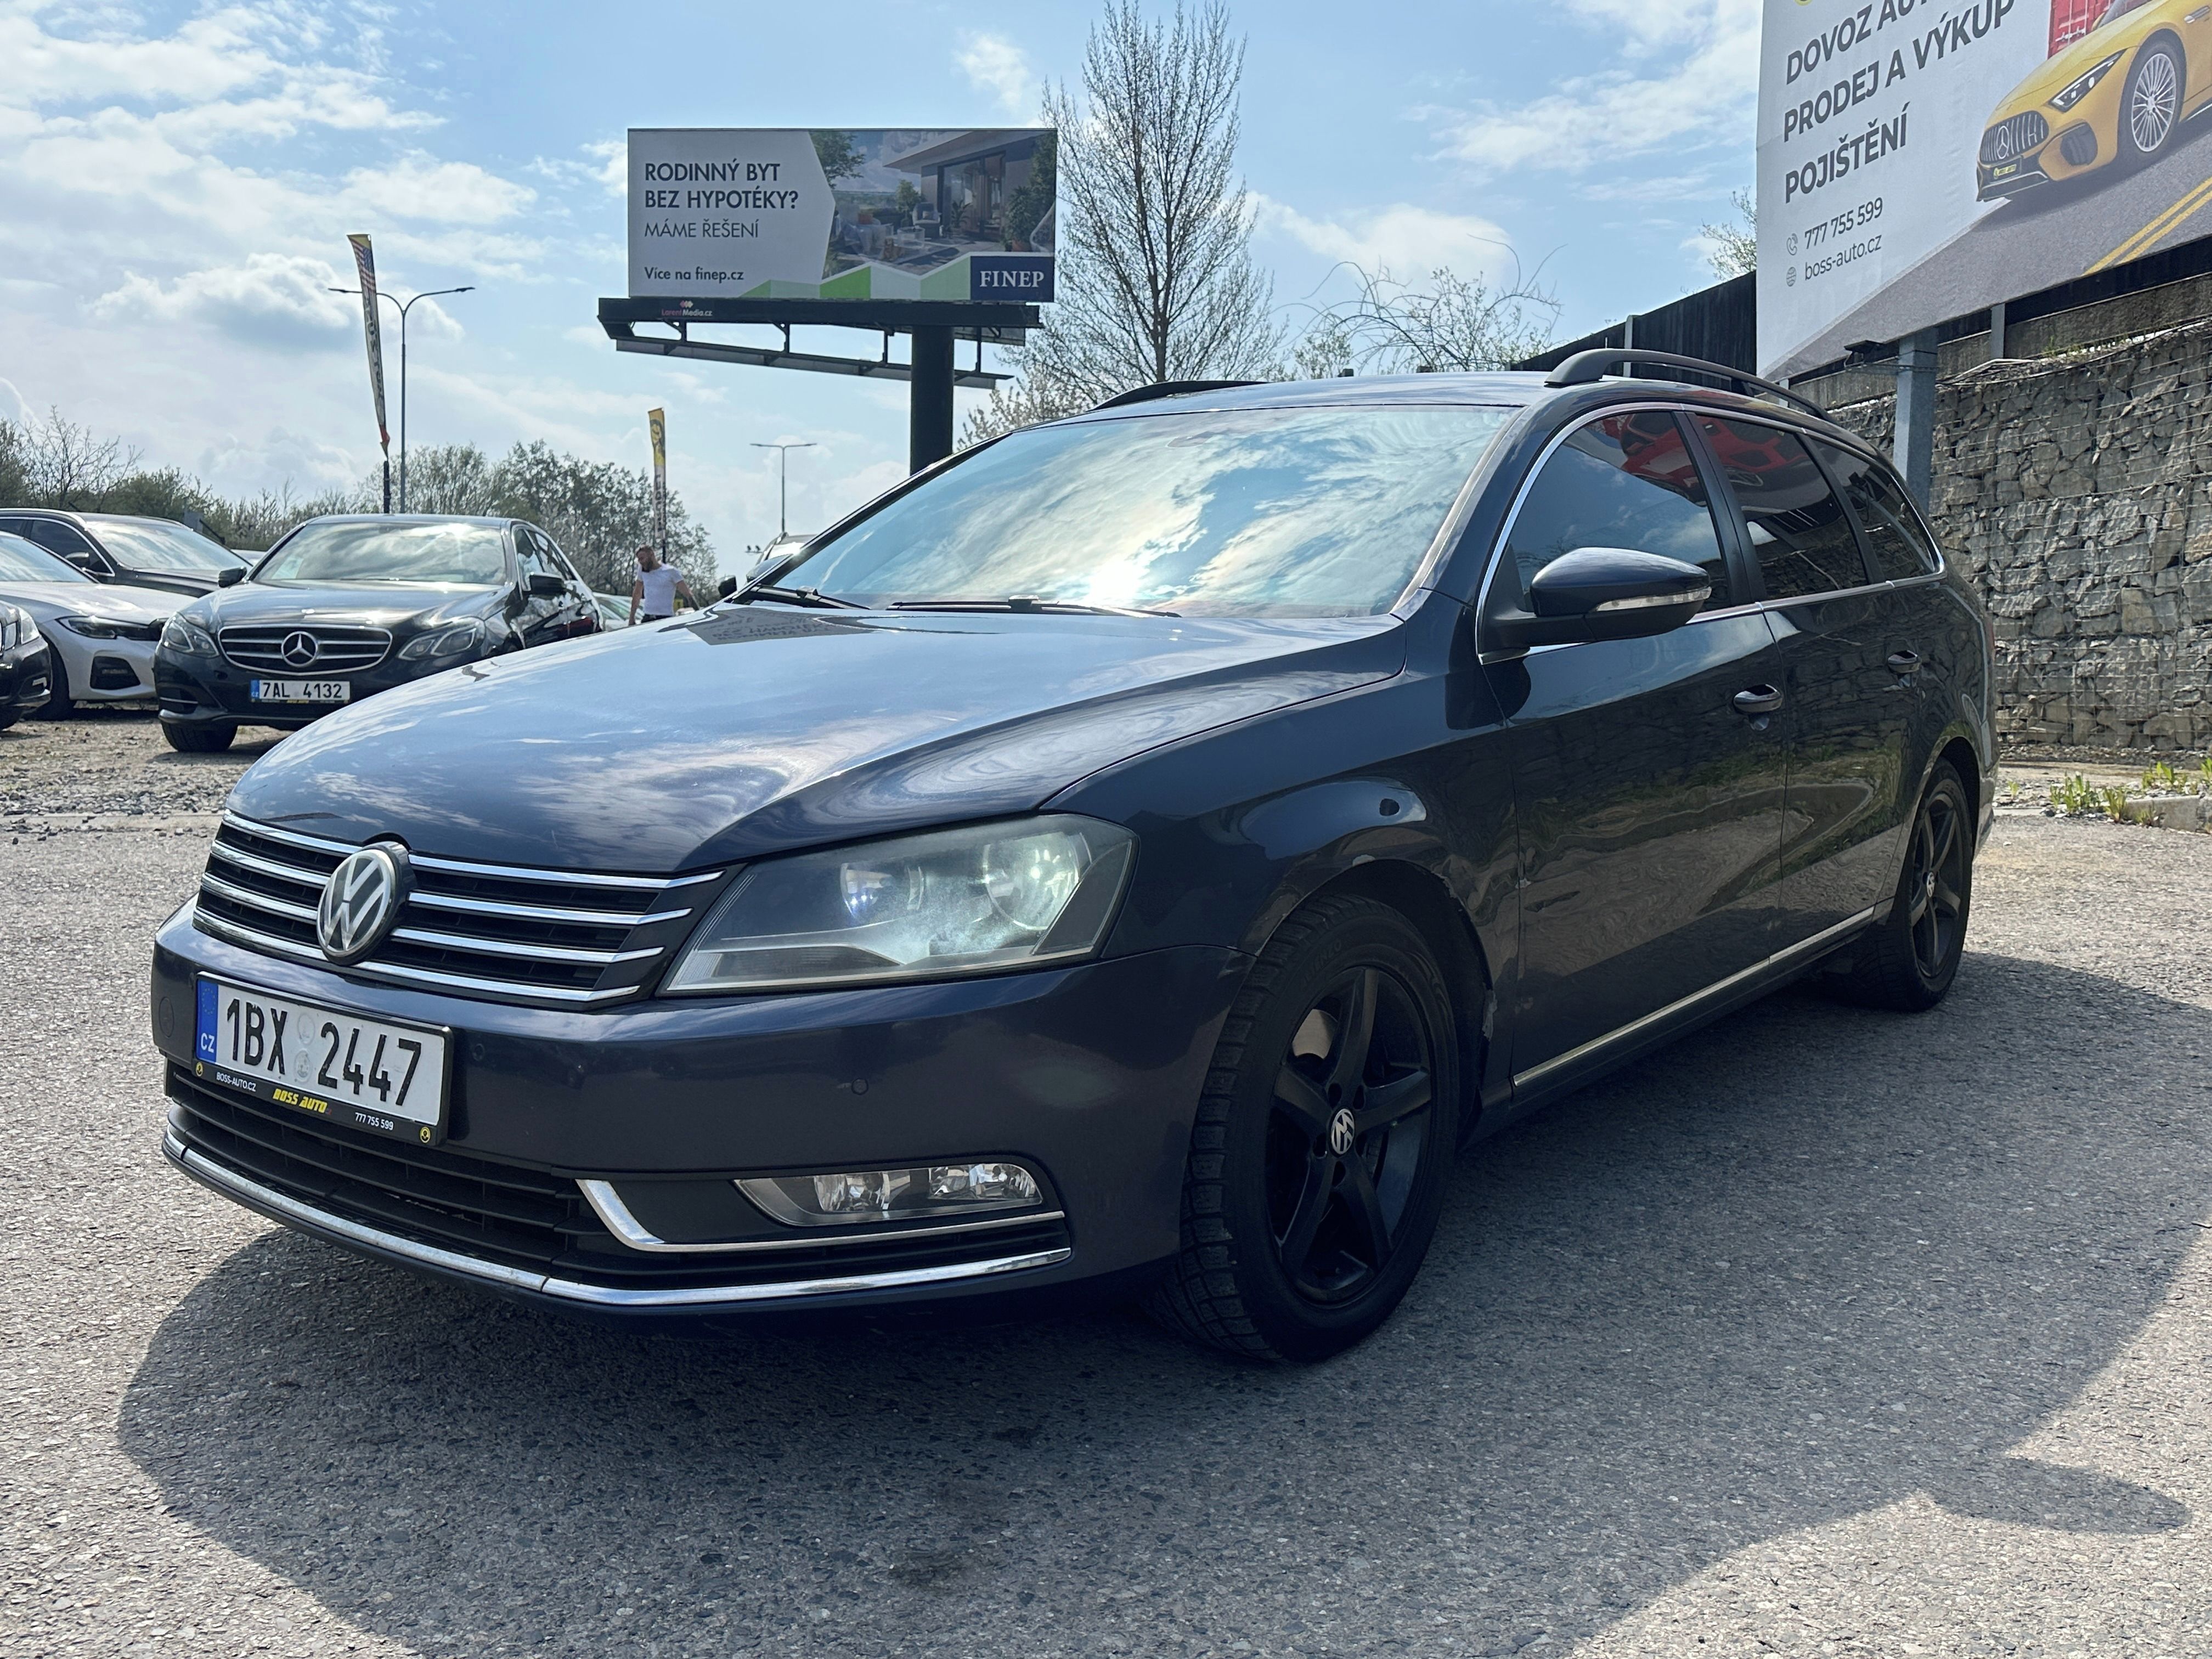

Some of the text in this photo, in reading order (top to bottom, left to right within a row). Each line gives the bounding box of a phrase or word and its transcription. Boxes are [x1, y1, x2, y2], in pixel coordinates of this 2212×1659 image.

[1786, 4, 1872, 85] DOVOZ
[1784, 60, 1880, 143] PRODEJ
[1884, 48, 1906, 88] A
[1785, 100, 1911, 204] POJIŠTĚNÍ
[645, 158, 781, 182] RODINNÝ BYT
[645, 185, 799, 209] BEZ HYPOTÉKY?
[644, 218, 759, 238] MÁME ŘEŠENÍ
[1804, 197, 1883, 250] 777 755 599
[1804, 234, 1882, 281] boss-auto.cz
[644, 266, 744, 283] Více na finep.cz
[979, 270, 1044, 287] FINEP
[263, 682, 342, 698] 7AL 4132
[201, 1033, 215, 1053] CZ
[227, 998, 421, 1107] 1BX 2447
[216, 1071, 257, 1092] BOSS-AUTO.CZ
[273, 1088, 299, 1105] BOSS
[299, 1096, 328, 1114] AUTO
[355, 1112, 394, 1131] 777 755 599
